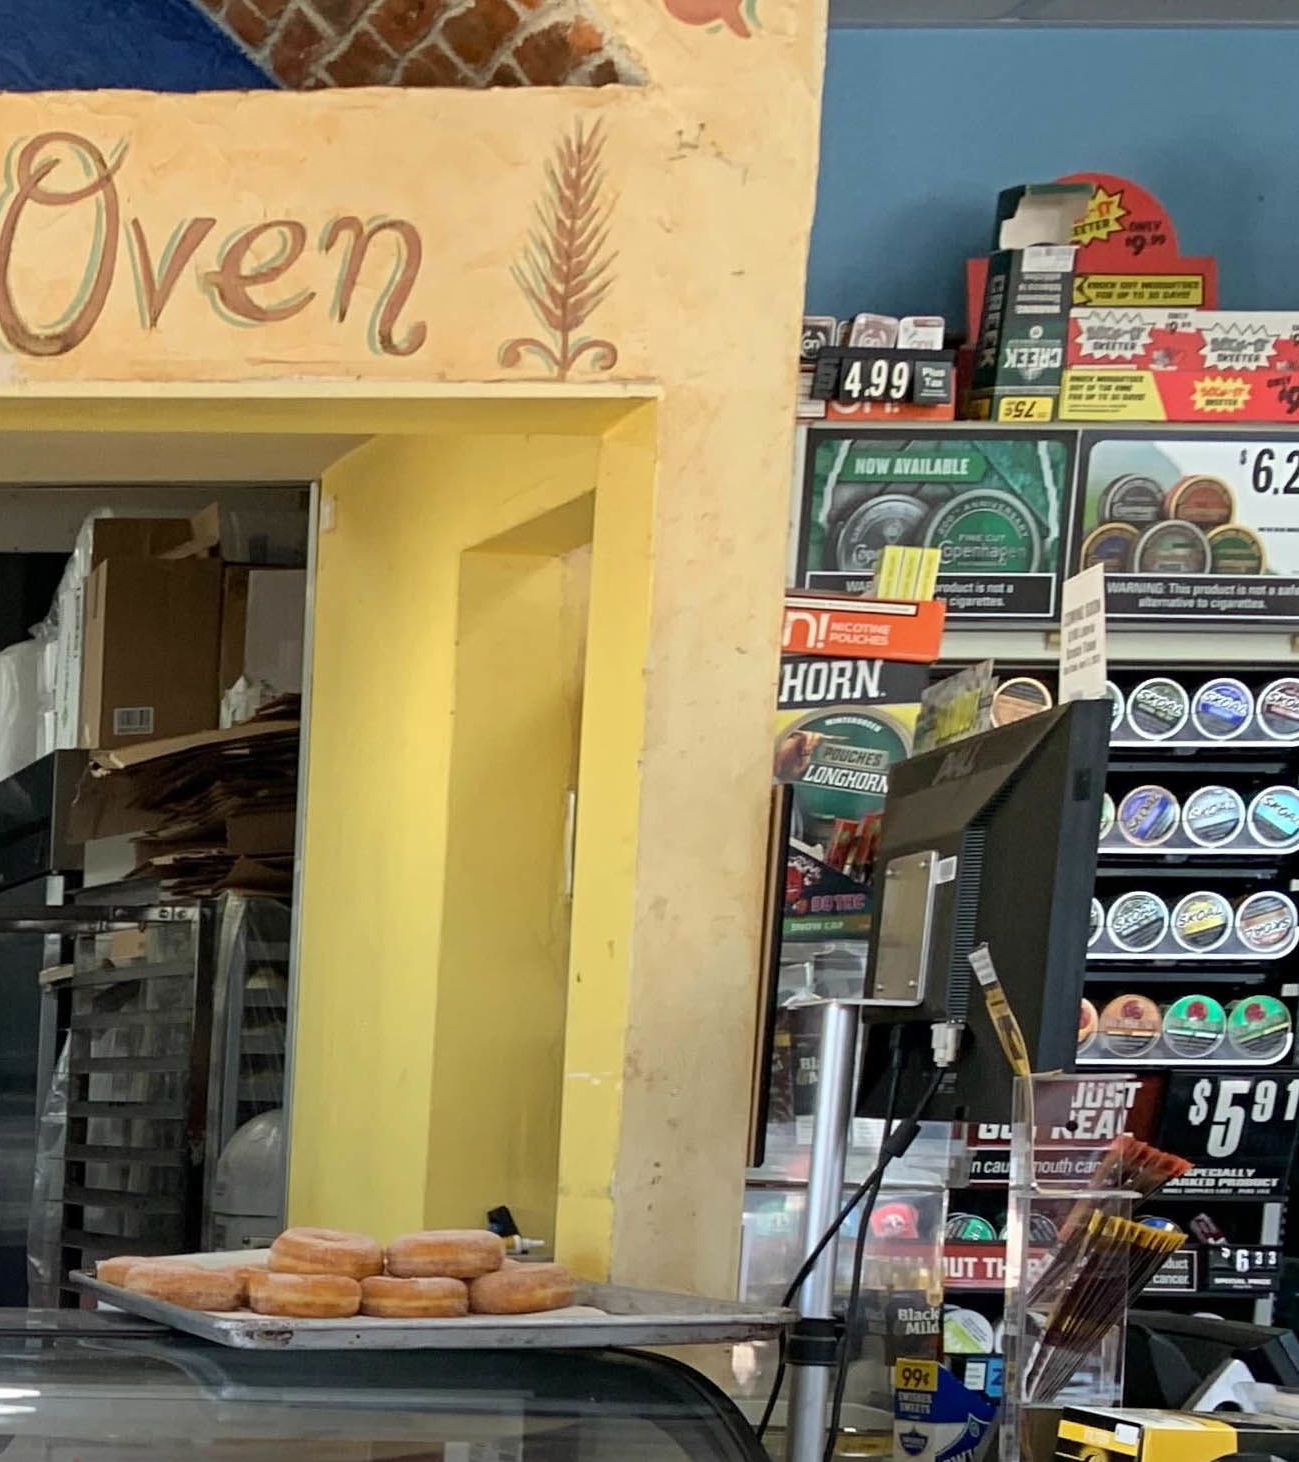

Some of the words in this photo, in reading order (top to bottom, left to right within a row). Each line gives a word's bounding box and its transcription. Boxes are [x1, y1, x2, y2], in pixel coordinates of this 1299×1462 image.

[1003, 347, 1064, 368] CREEK
[843, 358, 911, 399] 4.99
[855, 458, 888, 475] NOW
[893, 458, 970, 475] AVAILABLE
[1107, 582, 1165, 595] WARNING:
[1169, 582, 1191, 595] This
[1193, 583, 1235, 597] product
[1249, 583, 1266, 595] not
[831, 622, 892, 636] NICOTINE
[829, 634, 890, 646] POUCHES
[1137, 689, 1184, 718] SKOAL
[1203, 690, 1249, 716] SKOAL
[822, 746, 884, 766] POUCHES
[1189, 799, 1237, 820] SKOAL
[1177, 906, 1223, 927] SKOAL
[1071, 1081, 1143, 1109] JUST
[897, 1308, 941, 1321] Black
[904, 1321, 940, 1335] Mild
[902, 1367, 930, 1387] 99¢
